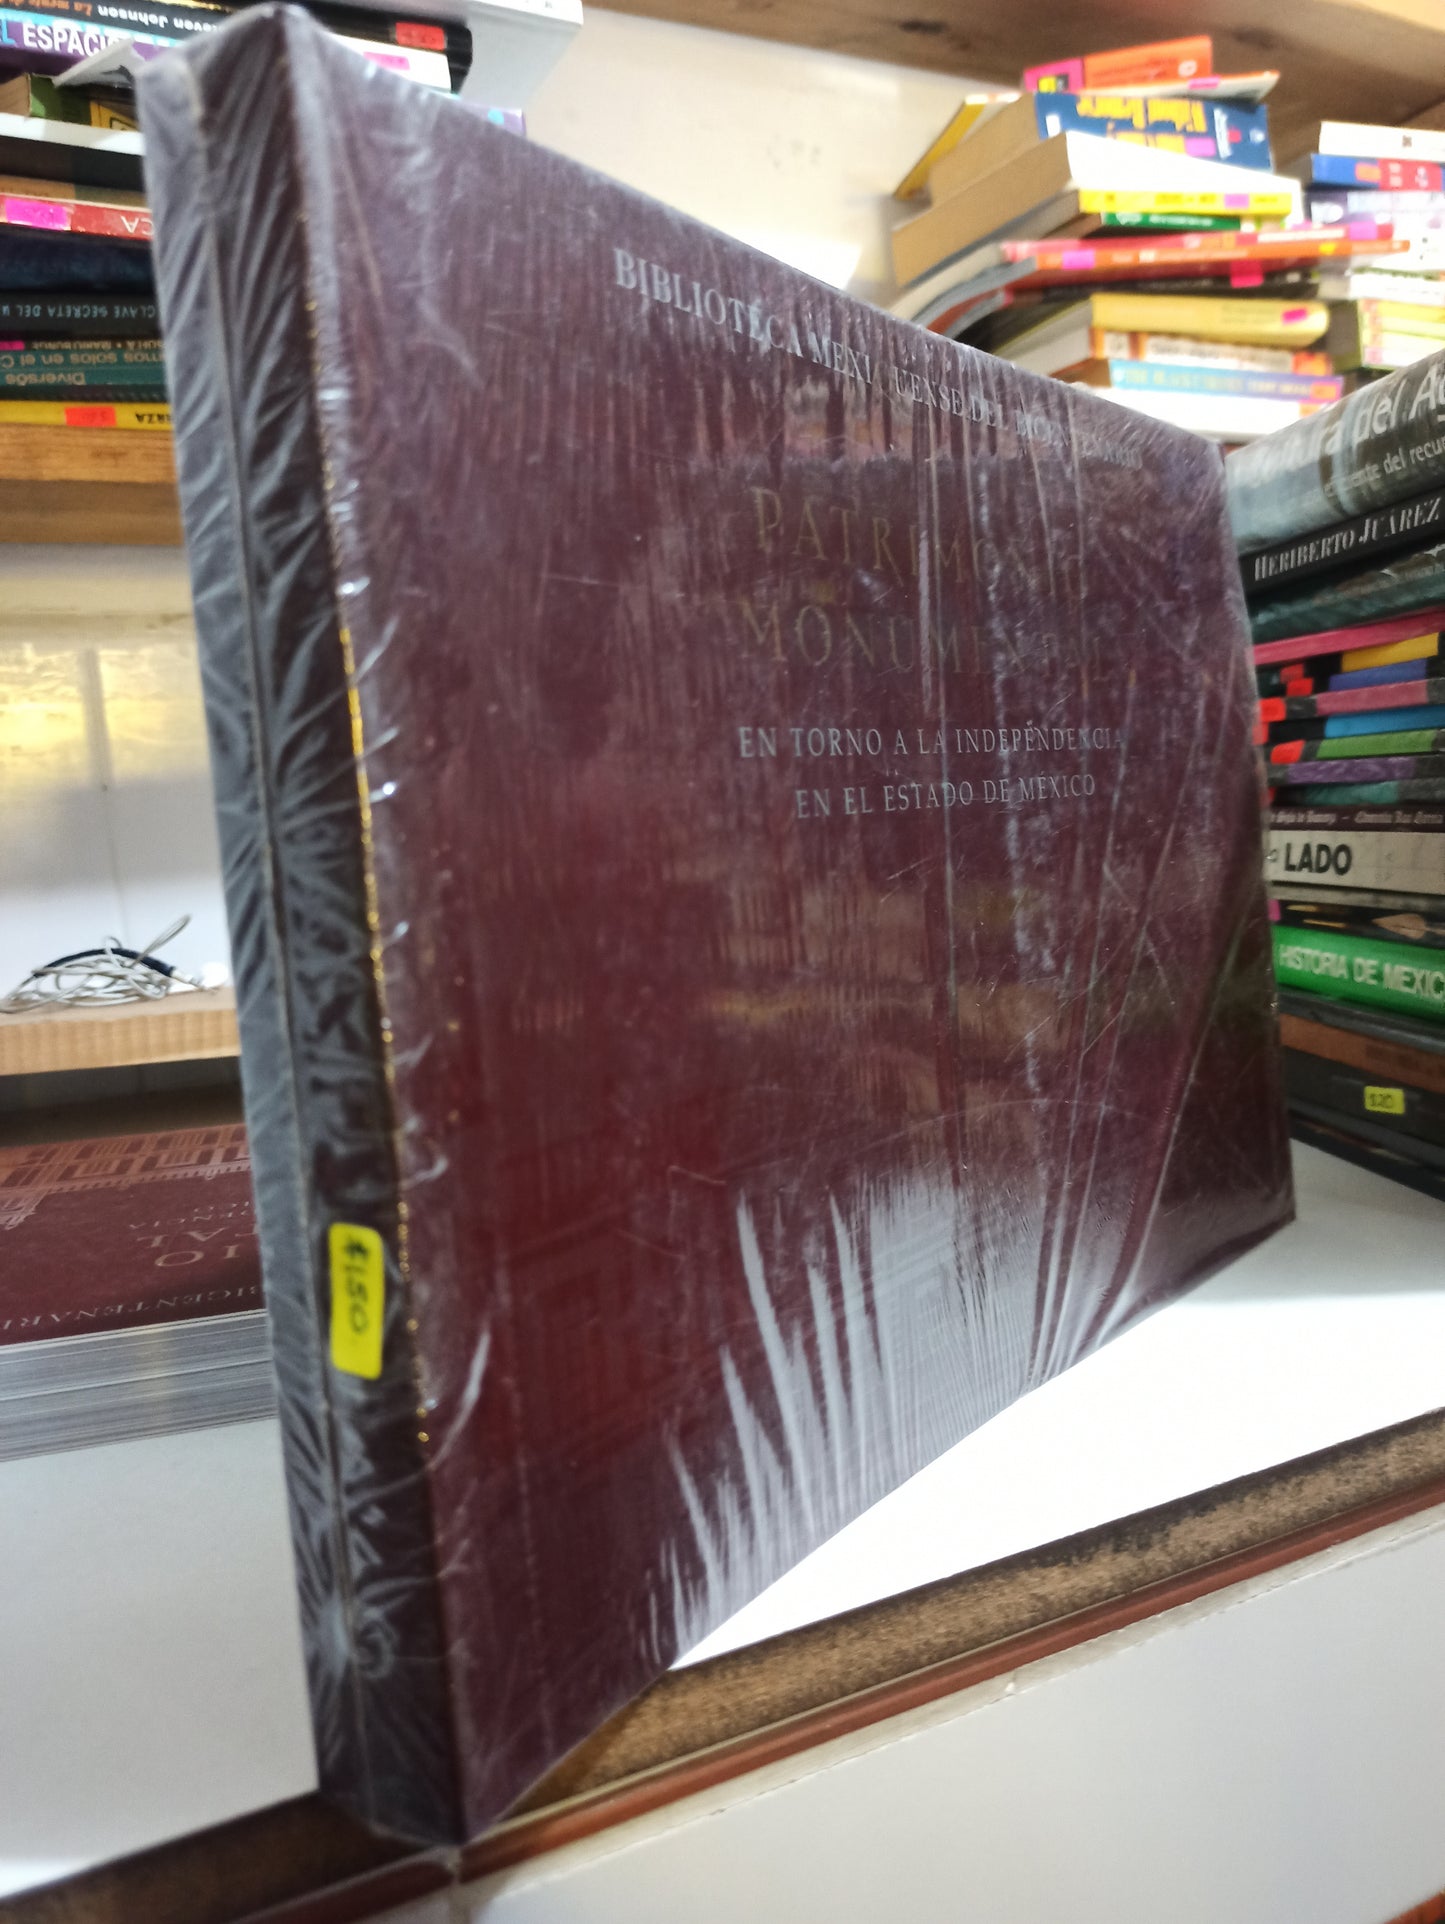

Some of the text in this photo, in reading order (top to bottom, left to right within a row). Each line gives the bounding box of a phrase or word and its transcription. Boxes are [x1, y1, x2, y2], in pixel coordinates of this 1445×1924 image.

[97, 5, 168, 29] Johnson
[613, 247, 804, 358] BIBLIOTECA
[808, 329, 963, 416] MEXIUENSE
[1383, 446, 1407, 475] del
[1254, 529, 1355, 581] HERIBERTO
[739, 727, 777, 758] EN
[789, 728, 882, 757] TORNO
[893, 729, 908, 756] A
[918, 728, 946, 755] LA
[795, 771, 1096, 819] EN EL ESTADO DE MÉXICO
[1285, 842, 1352, 876] LADO
[1279, 944, 1348, 979] HISTORIA
[1353, 957, 1379, 985] DE
